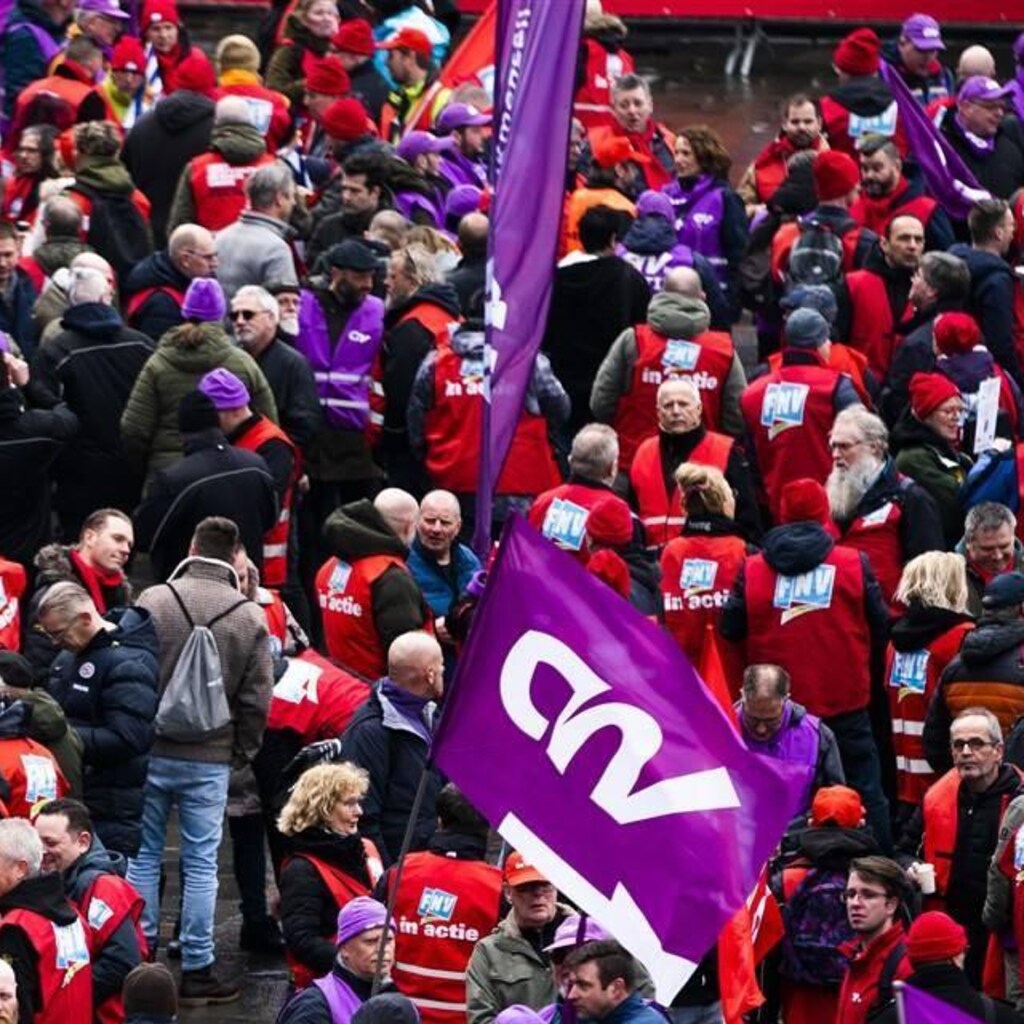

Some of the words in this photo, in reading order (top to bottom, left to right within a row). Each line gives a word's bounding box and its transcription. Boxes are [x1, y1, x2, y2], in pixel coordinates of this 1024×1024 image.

[763, 387, 810, 421] FNV
[665, 590, 683, 611] in
[687, 588, 729, 609] acti
[777, 570, 833, 602] FNV
[420, 893, 456, 917] FNV
[399, 915, 418, 933] in
[424, 921, 480, 942] actie
